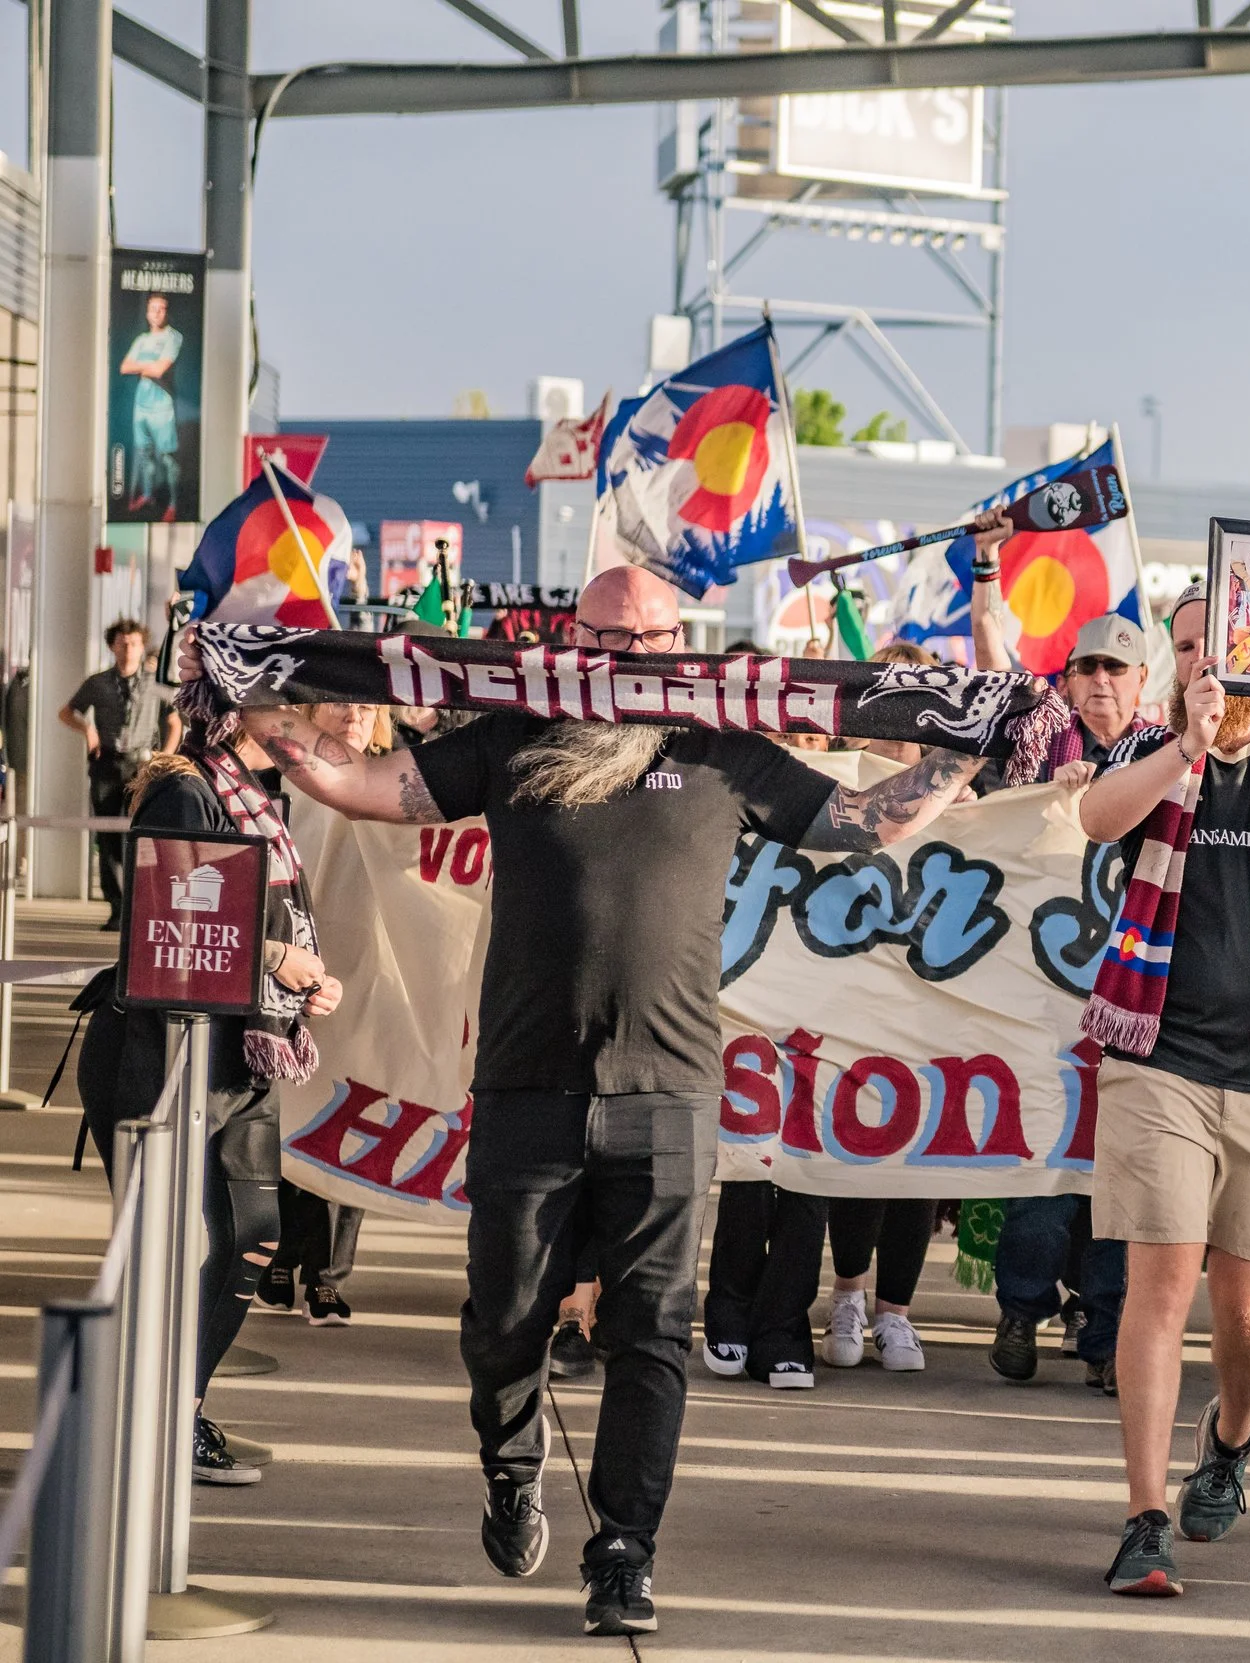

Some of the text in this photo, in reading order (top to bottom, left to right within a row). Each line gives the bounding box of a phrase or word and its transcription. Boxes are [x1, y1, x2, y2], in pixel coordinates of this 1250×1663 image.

[121, 269, 194, 294] HEADWATERS
[1106, 473, 1125, 514] Ryan
[862, 542, 905, 560] Forever
[540, 582, 580, 608] C3
[420, 826, 493, 891] VO
[147, 919, 241, 948] ENTER
[153, 945, 232, 973] HERE
